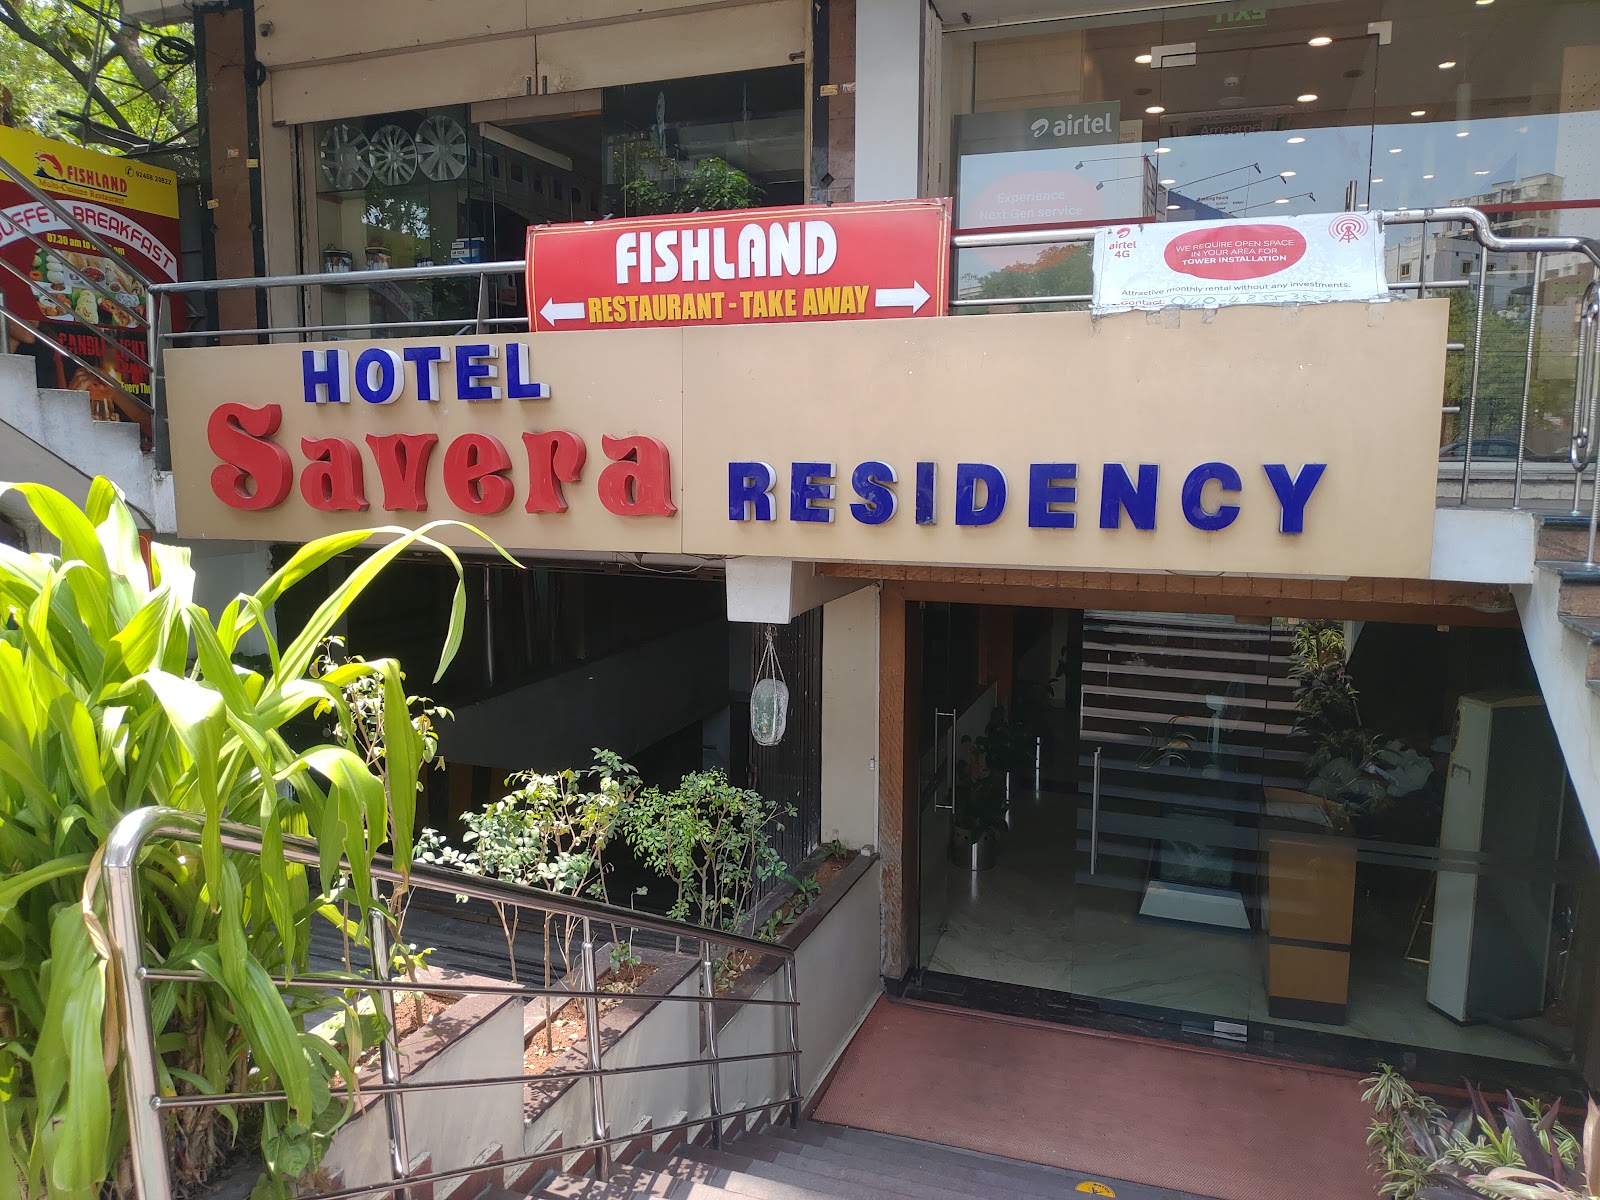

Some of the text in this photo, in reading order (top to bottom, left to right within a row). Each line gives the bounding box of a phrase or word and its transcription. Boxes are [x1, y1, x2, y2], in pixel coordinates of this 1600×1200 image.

[1053, 113, 1112, 137] airtel
[67, 164, 128, 194] FISHLAND
[89, 188, 125, 205] Restaurant
[996, 190, 1066, 205] Experience
[978, 204, 1084, 222] Next Gen service
[46, 232, 69, 246] 07.30
[69, 238, 82, 248] am
[82, 239, 91, 249] to
[72, 205, 174, 270] BREAKFAST
[1109, 240, 1137, 250] airtel
[1192, 241, 1233, 250] REQUIRE
[1234, 239, 1261, 248] OPEN
[1263, 239, 1294, 247] SPACE
[615, 220, 838, 284] FISHLAND
[1114, 249, 1131, 258] 4G
[1182, 255, 1287, 265] TOWER INSTALLATION
[1166, 286, 1204, 294] monthly
[1290, 280, 1352, 288] investments.
[588, 291, 726, 323] RESTAURANT
[740, 288, 797, 318] TAKE
[802, 285, 870, 316] AWAY
[302, 342, 551, 404] HOTEL
[207, 402, 678, 518] Savera
[727, 460, 1328, 534] RESIDENCY
